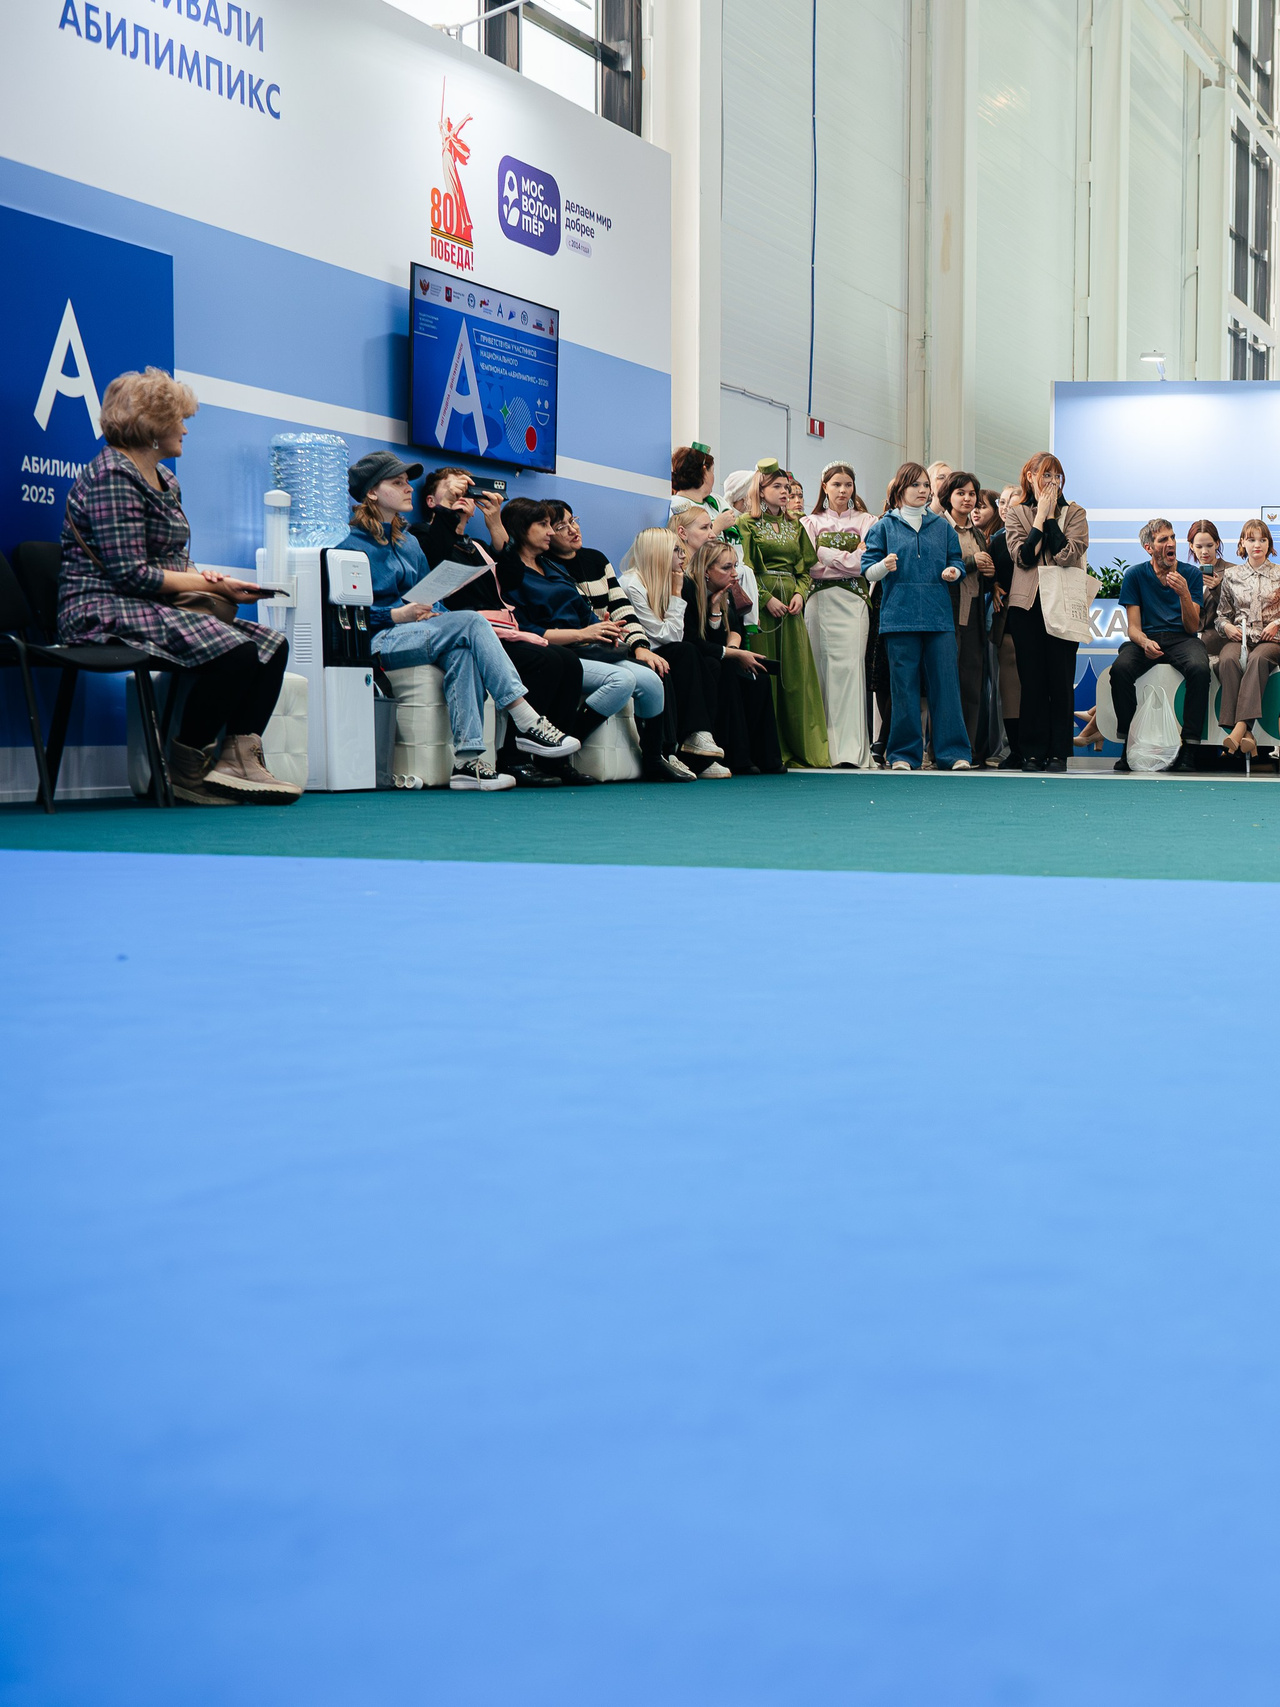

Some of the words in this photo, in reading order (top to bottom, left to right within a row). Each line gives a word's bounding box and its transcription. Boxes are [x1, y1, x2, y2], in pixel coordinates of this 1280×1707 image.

[151, 0, 263, 52] ВАЛИ
[58, 0, 280, 120] АБИЛИМПИКС
[521, 176, 545, 201] МОС
[430, 187, 457, 235] 80
[521, 195, 557, 225] ВОЛОН
[565, 199, 595, 222] делаем
[596, 212, 612, 232] мир
[565, 217, 595, 239] добрее
[430, 236, 474, 271] ПОБЕДА!
[21, 455, 88, 479] АБИЛИМ
[21, 484, 55, 504] 2025
